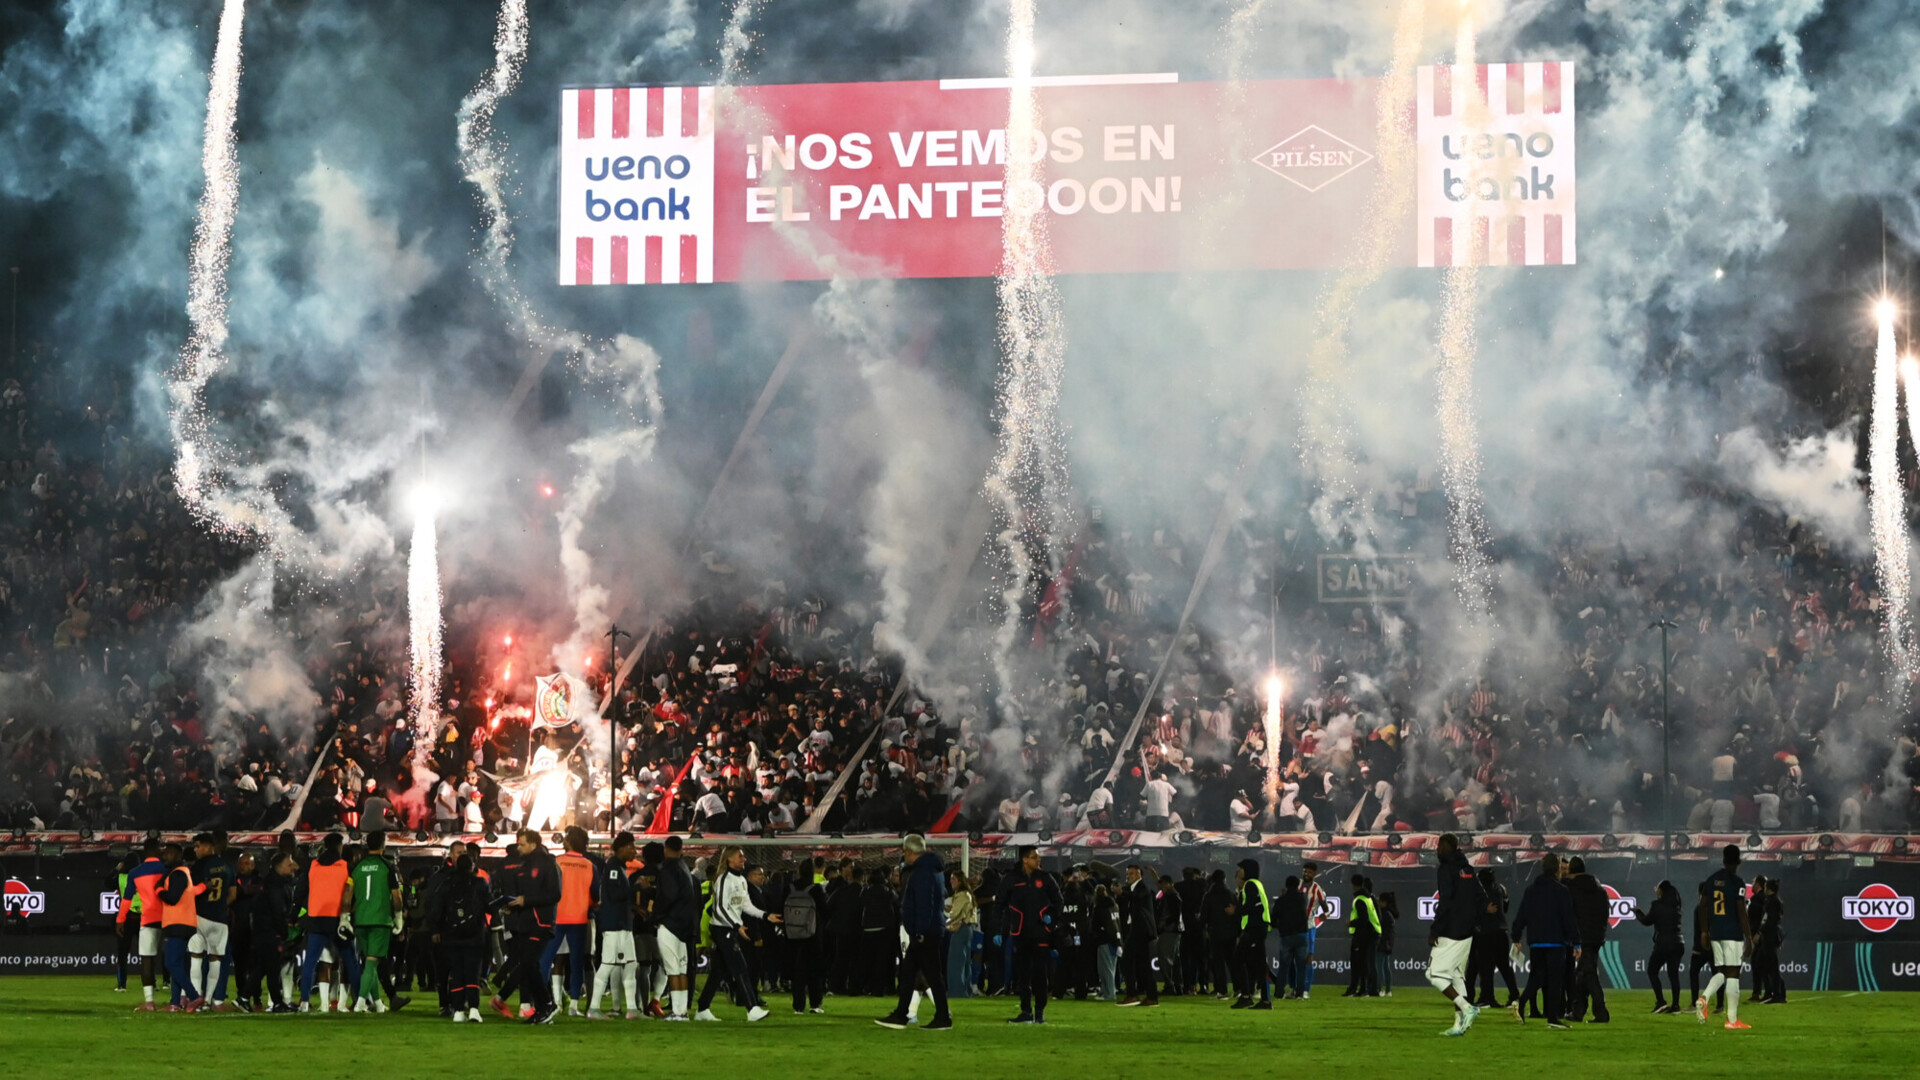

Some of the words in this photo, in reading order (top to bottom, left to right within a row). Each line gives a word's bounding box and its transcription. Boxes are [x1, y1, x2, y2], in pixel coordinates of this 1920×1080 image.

[746, 132, 873, 179] ¡NOS
[1104, 124, 1175, 161] EN
[1270, 150, 1355, 168] PILSEN
[1442, 132, 1553, 160] ueno
[585, 154, 690, 181] ueno
[1443, 166, 1554, 202] bank
[585, 187, 690, 222] bank
[746, 186, 810, 222] EL
[366, 874, 371, 901] 1
[5, 895, 40, 910] KYO
[1713, 890, 1726, 916] 2
[1847, 900, 1909, 916] TOKYO
[0, 956, 21, 965] nco
[24, 955, 88, 968] paraguayo
[91, 953, 107, 965] de
[1311, 960, 1351, 973] paragu
[1394, 958, 1428, 970] todos
[1634, 960, 1646, 972] El
[1779, 960, 1809, 973] odos
